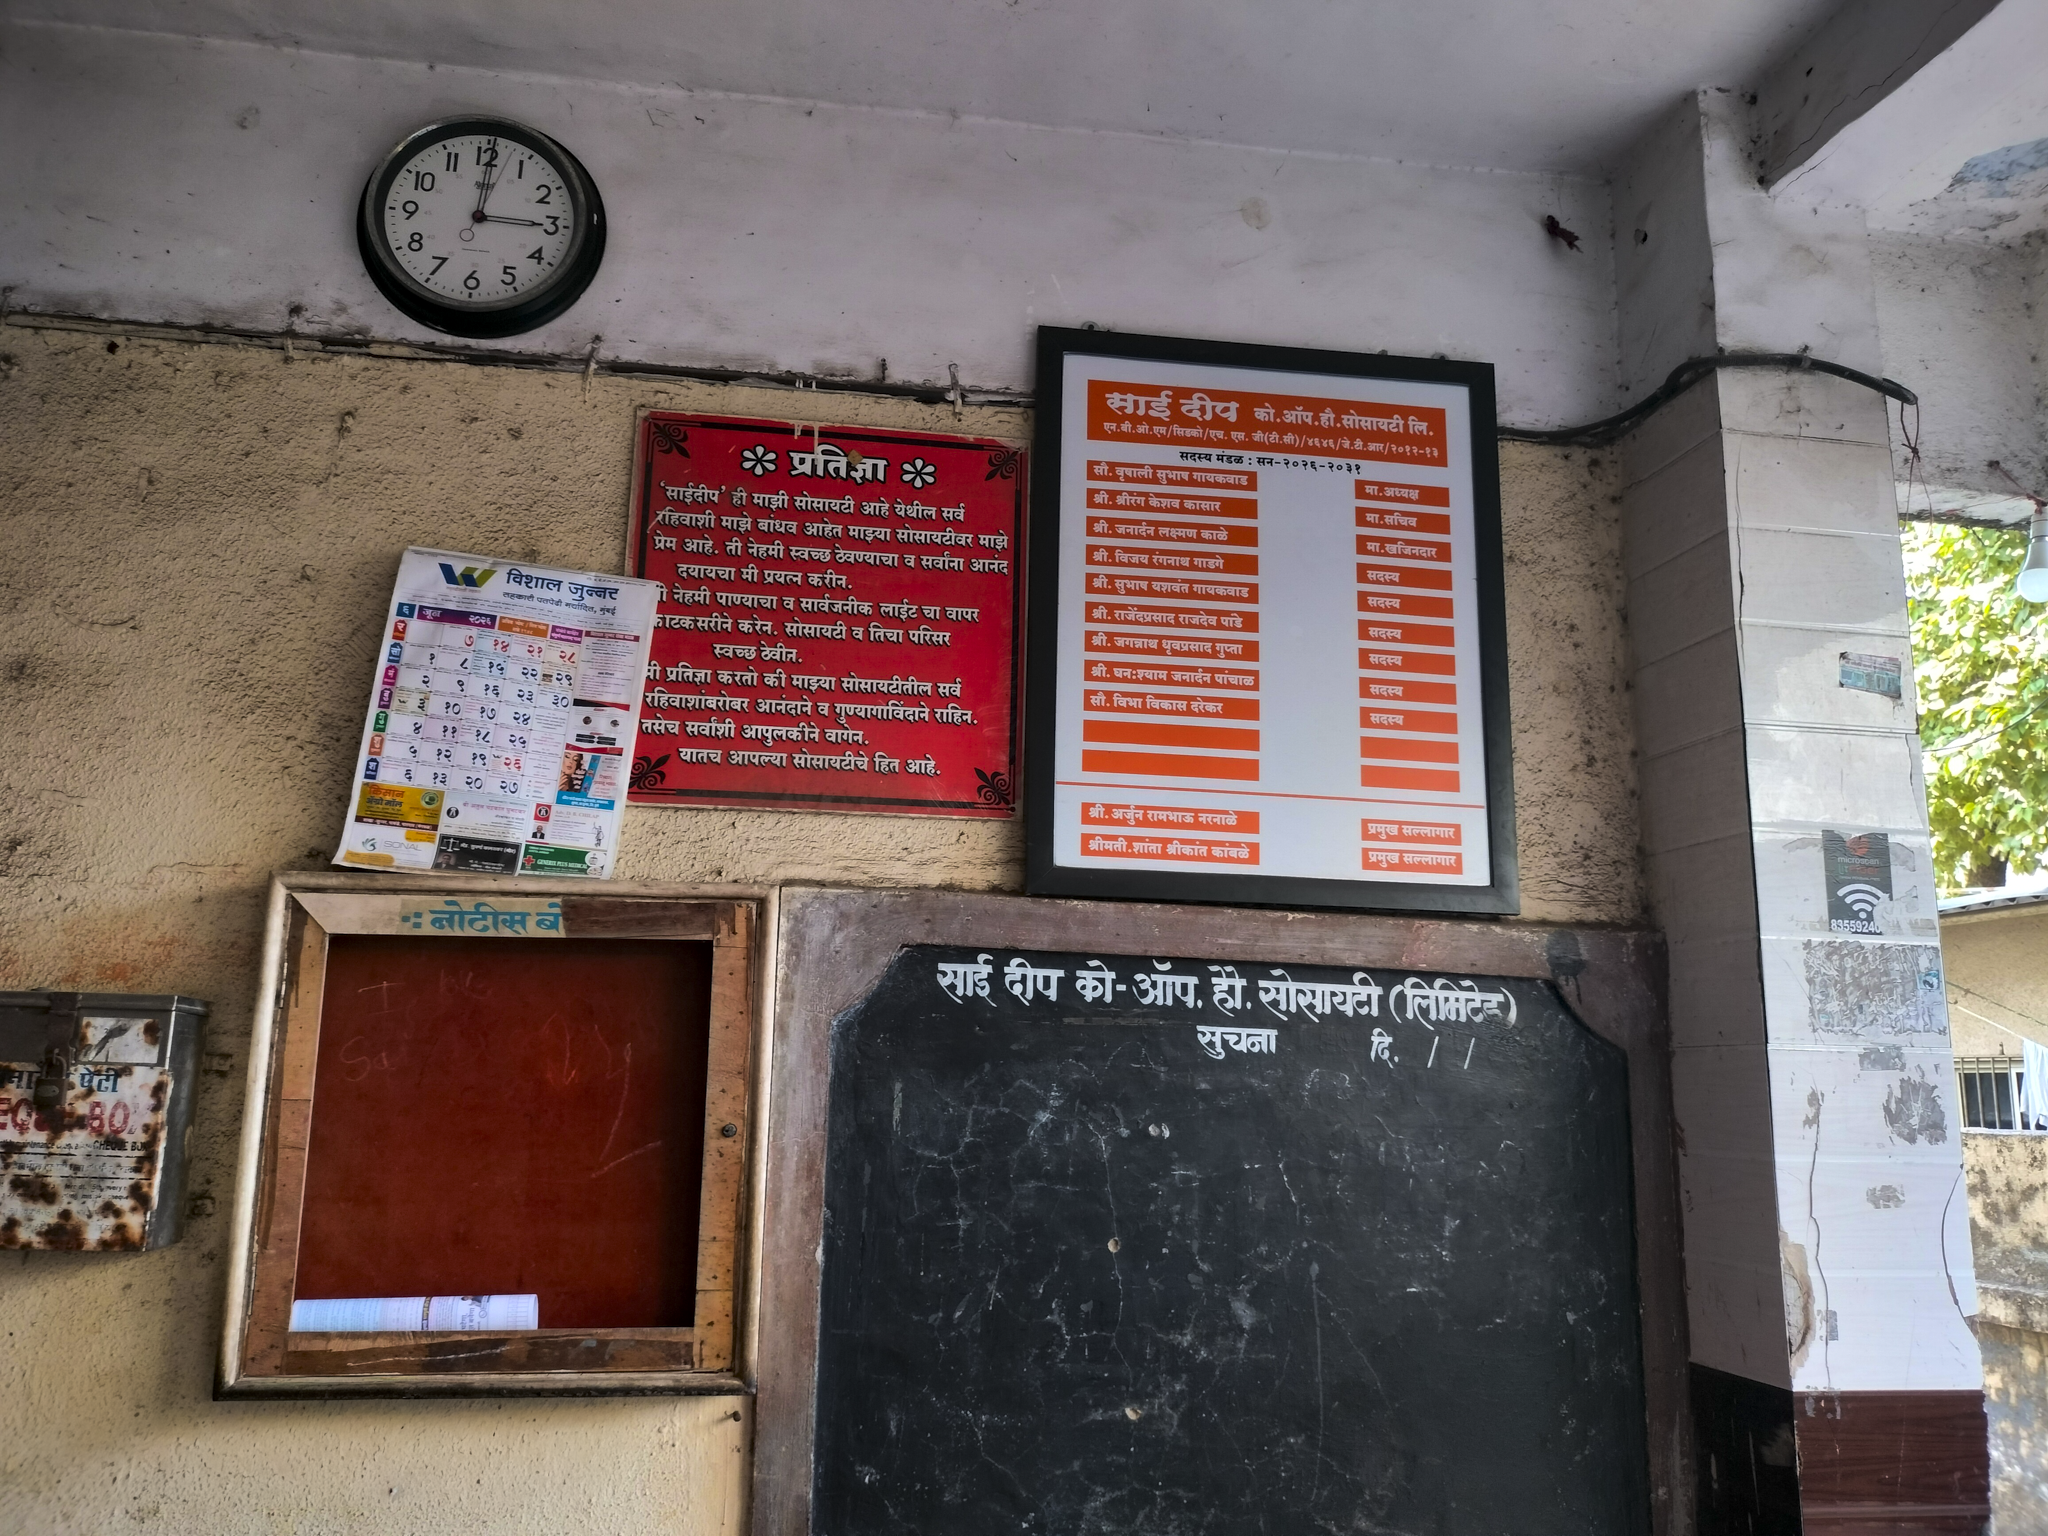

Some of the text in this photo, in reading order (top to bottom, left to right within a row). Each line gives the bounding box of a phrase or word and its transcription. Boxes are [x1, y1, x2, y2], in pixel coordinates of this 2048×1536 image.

[445, 151, 459, 172] 11
[475, 146, 499, 168] 12
[517, 159, 524, 180] 1
[414, 170, 436, 192] 10
[535, 184, 552, 204] 2
[402, 200, 419, 220] 9
[543, 215, 560, 236] 3
[407, 232, 424, 252] 8
[431, 255, 449, 276] 7
[526, 246, 545, 265] 4
[463, 270, 481, 290] 6
[500, 265, 517, 286] 5
[1105, 390, 1173, 421] साई
[1180, 392, 1239, 422] दीप
[1408, 416, 1434, 435] लि.
[789, 444, 888, 483] प्रतिज्ञा
[1180, 451, 1212, 462] सदस्य
[1216, 451, 1244, 465] मंडळ
[1116, 466, 1152, 481] वृषाली
[1157, 470, 1189, 484] सुभाष
[1193, 472, 1248, 485] गायकवाड
[731, 487, 747, 506] ही
[752, 490, 788, 511] माझी
[794, 492, 854, 513] सोसायटी
[861, 498, 889, 517] आहे
[895, 498, 936, 519] येथील
[941, 503, 964, 521] सर्व
[1093, 492, 1220, 512] श्री. श्रीरंग केशव कासार
[656, 507, 1008, 551] रहिवाशी माझे बांधव आहेत माझ्या सोसायटीवर माझे
[1365, 512, 1417, 527] मा.सचिव
[1093, 520, 1228, 541] श्री. जनार्दन लक्ष्मण काळे
[654, 530, 677, 550] प्रेम
[683, 534, 719, 555] आहे.
[726, 537, 742, 556] ती
[747, 538, 784, 559] नेहमी
[789, 545, 831, 562] स्वच्छ
[835, 544, 898, 567] ठेवण्याचा
[904, 555, 915, 567] व
[970, 554, 1008, 574] आनंद
[1093, 548, 1224, 569] श्री. विजय रंगनाथ गाडगे
[1366, 541, 1437, 558] मा.खजिनदार
[507, 568, 562, 592] विशाल
[741, 564, 758, 582] मी
[763, 570, 802, 585] प्रयत्न
[807, 569, 852, 589] करीन.
[1092, 575, 1249, 597] श्री. सुभाष यशवंत गायकवाड
[1367, 570, 1400, 582] सदस्य
[503, 592, 534, 602] सहकारी
[600, 605, 616, 616] मुंबई
[1367, 597, 1400, 608] सदस्य
[423, 609, 442, 619] जून
[737, 614, 778, 635] करेन.
[785, 617, 846, 639] सोसायटी
[851, 627, 863, 640] व
[869, 622, 903, 643] तिचा
[909, 625, 951, 645] परिसर
[1368, 627, 1402, 639] सदस्य
[713, 641, 802, 662] स्वच्छ ठेवीन.
[1369, 654, 1402, 666] सदस्य
[522, 667, 537, 681] २२
[646, 660, 961, 697] मी प्रतिज्ञा करतो की माझ्या सोसायटीतील सर्व
[1369, 684, 1403, 696] सदस्य
[1090, 692, 1223, 713] सौ. विभा विकास दरेकर
[640, 713, 680, 735] तसेच
[742, 722, 819, 746] आपुलकीने
[825, 724, 869, 745] वागेन.
[1370, 713, 1404, 725] सदस्य
[679, 747, 941, 776] यातच आपल्या सोसायटीचे हित आहे.
[1089, 804, 1237, 825] श्री. अर्जुन रामभाऊ नरनाळे
[1368, 823, 1455, 839] प्रमुख सल्लागार
[384, 840, 421, 851] SONAL
[937, 954, 997, 1007] साई
[1004, 958, 1065, 1006] दीप
[1258, 969, 1383, 1022] सोसायटी
[1197, 1025, 1278, 1059] सुचना
